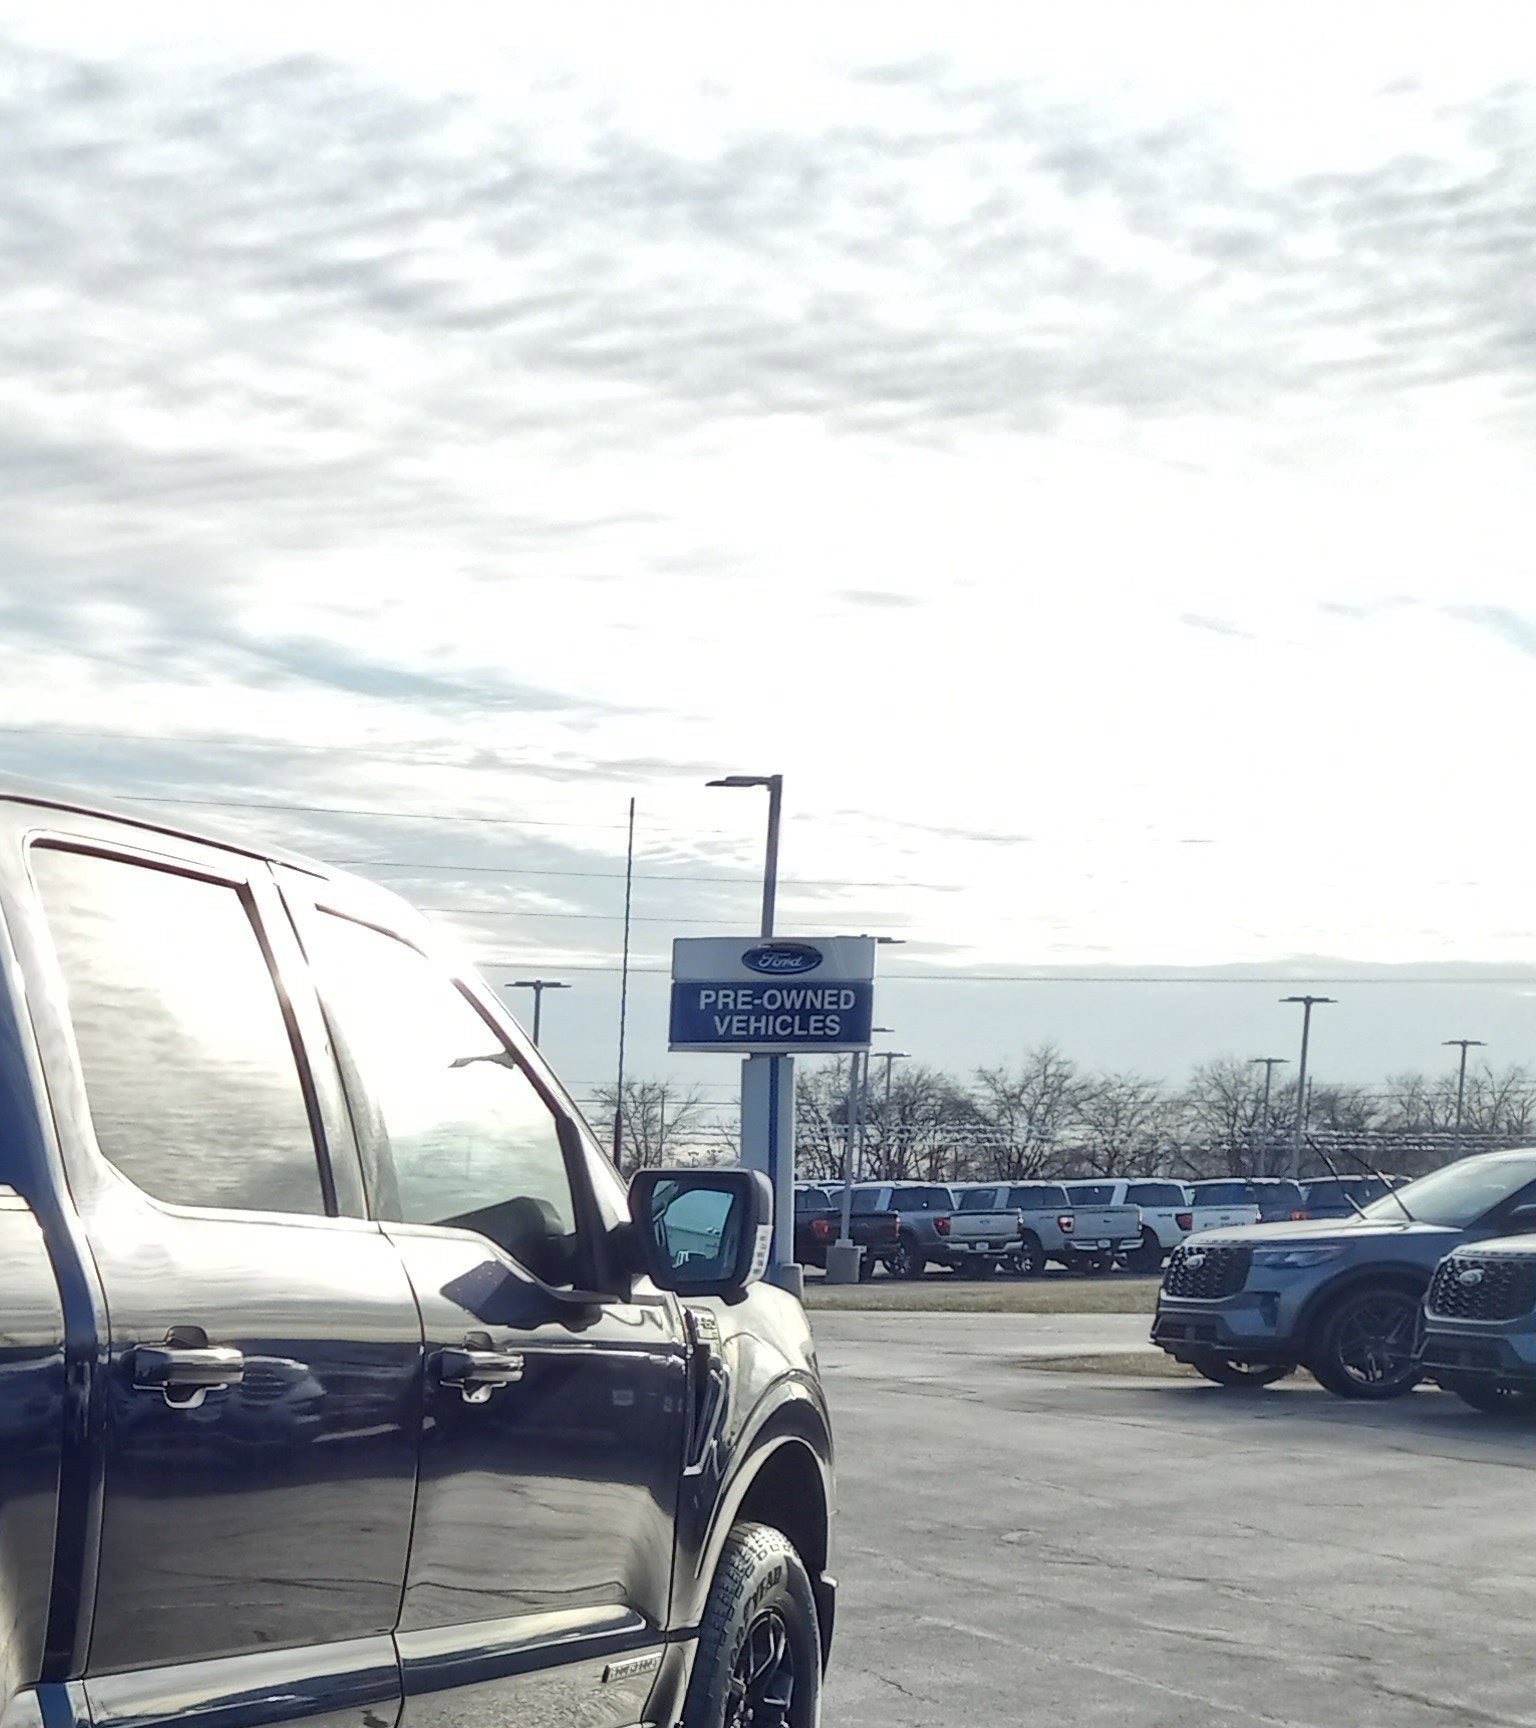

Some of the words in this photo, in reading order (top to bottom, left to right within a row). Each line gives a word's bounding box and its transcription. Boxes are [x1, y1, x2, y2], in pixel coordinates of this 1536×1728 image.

[758, 952, 803, 968] Ford
[699, 989, 856, 1010] PRE-OWNED
[714, 1015, 842, 1036] VEHICLES
